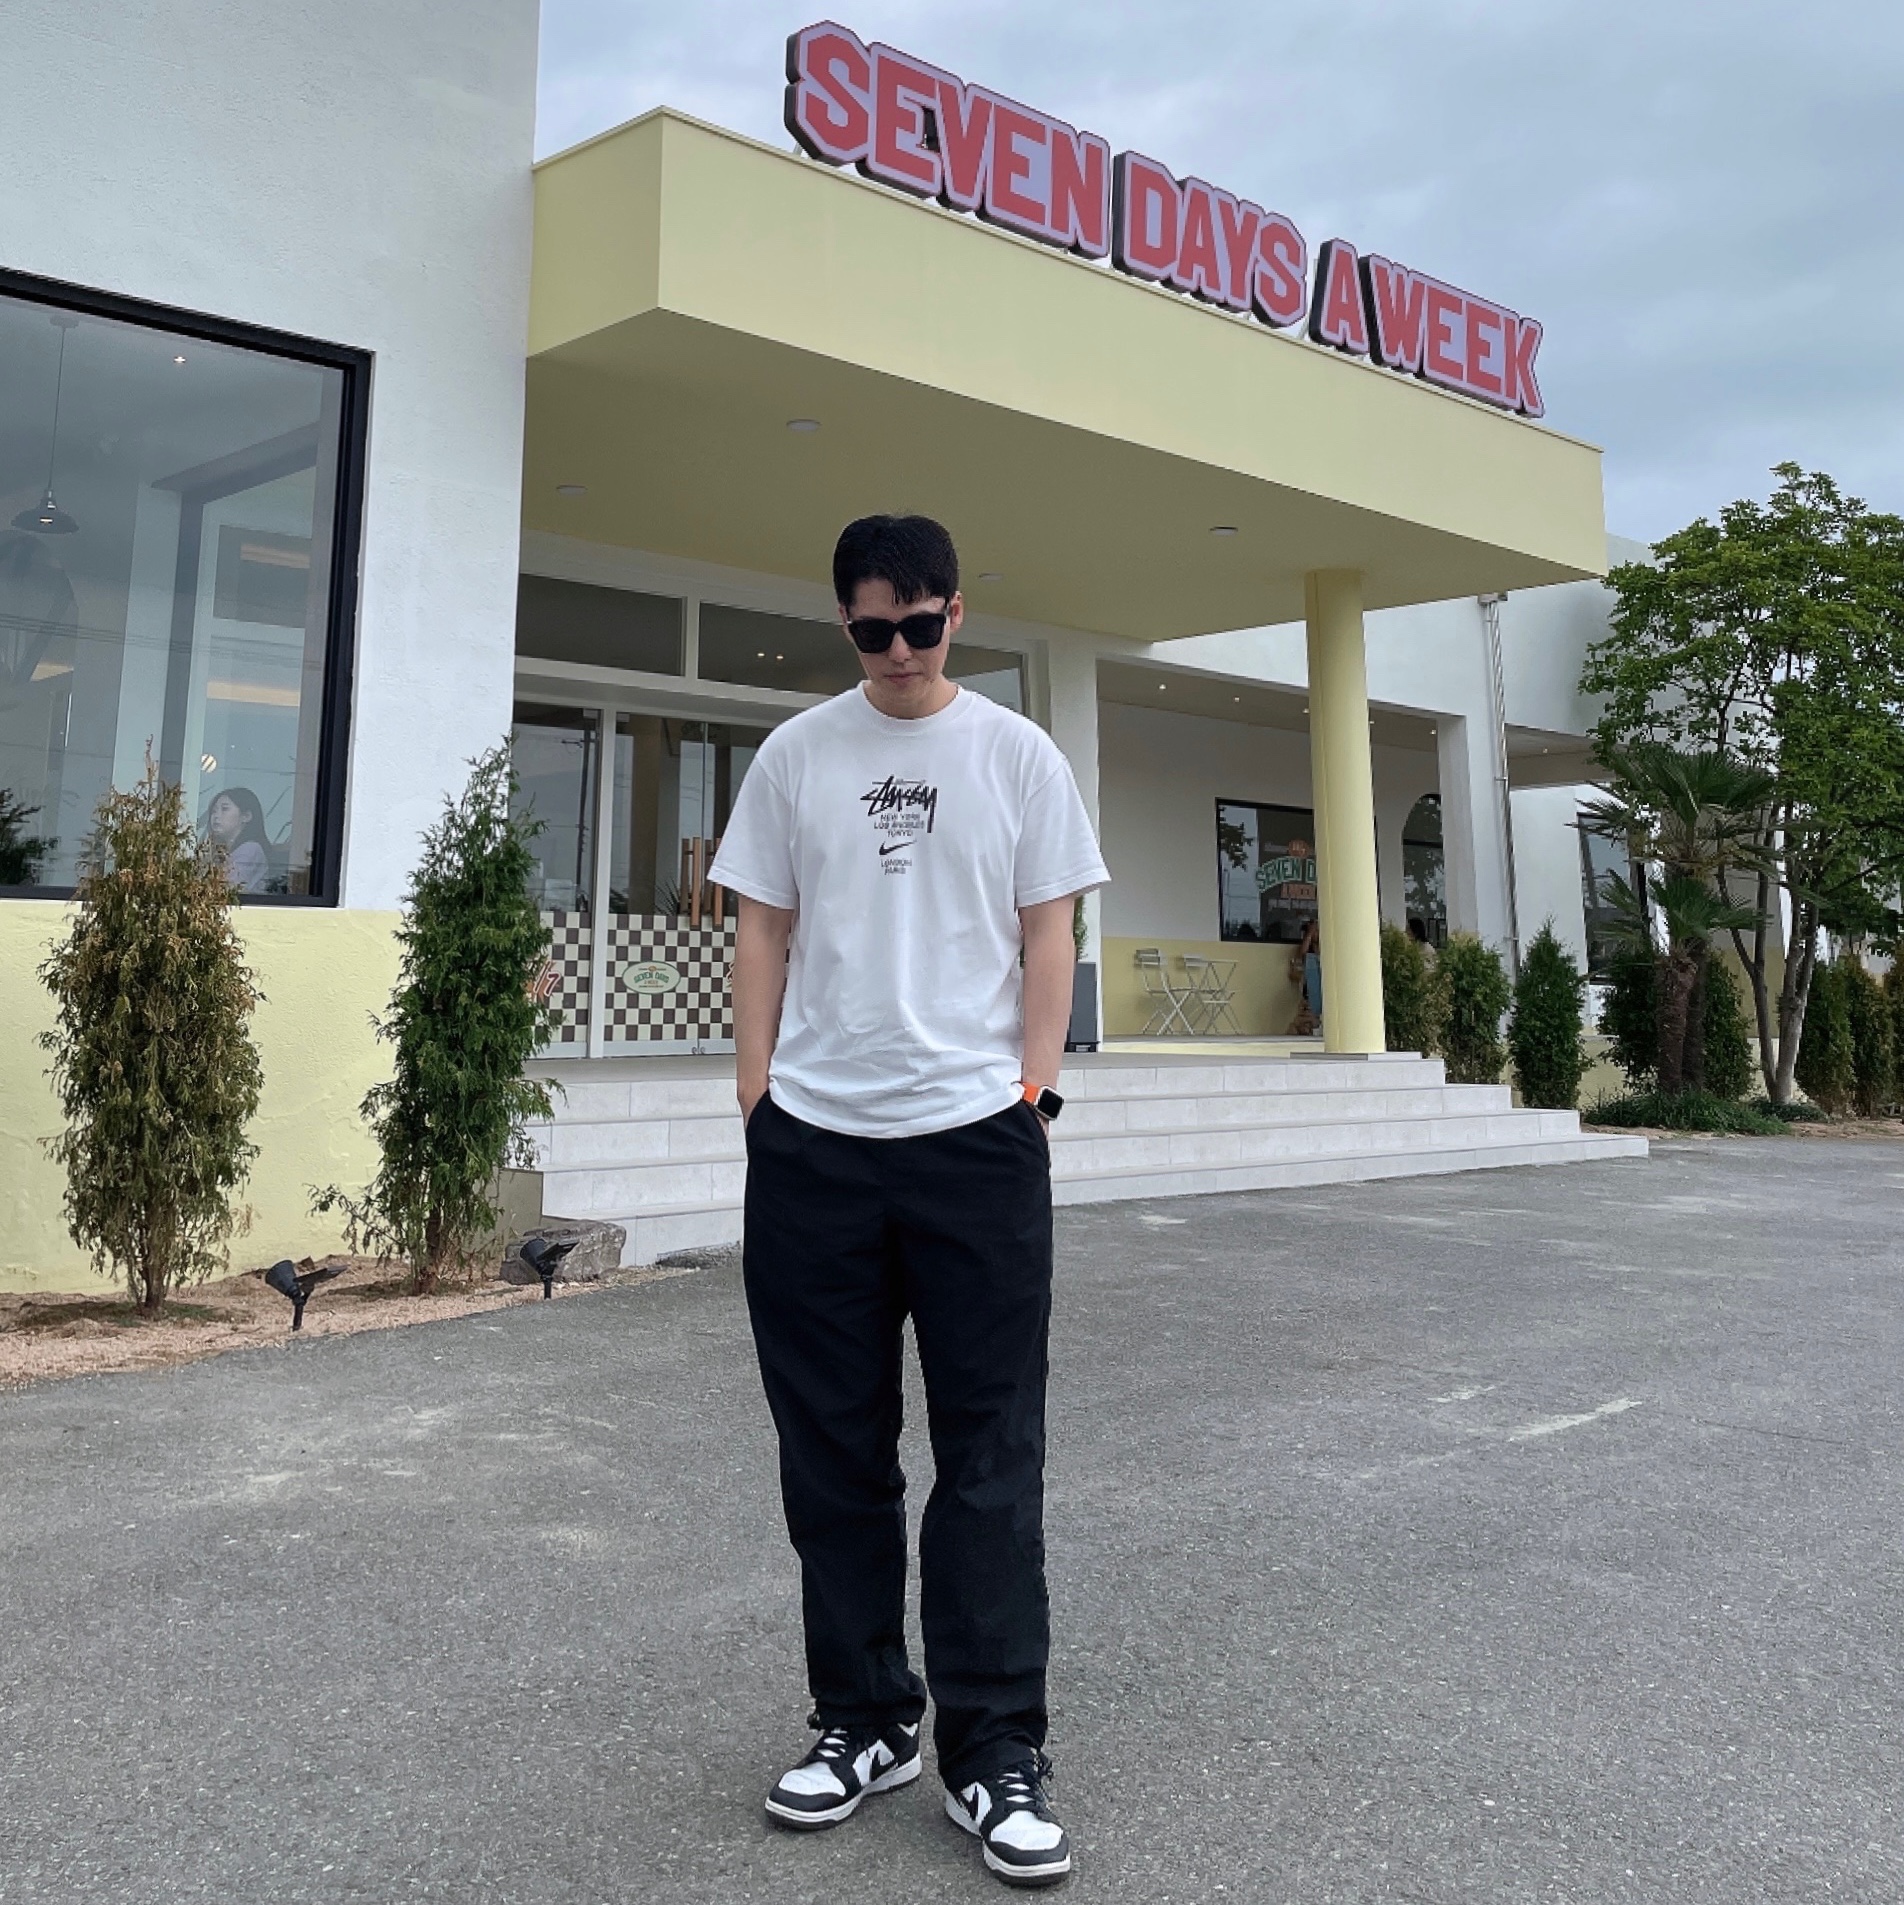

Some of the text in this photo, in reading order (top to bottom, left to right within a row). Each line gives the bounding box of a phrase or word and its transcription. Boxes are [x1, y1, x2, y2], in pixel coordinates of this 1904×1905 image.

[792, 20, 1544, 418] SEVEN DAYS A WEEK
[1256, 856, 1302, 893] SEVEN
